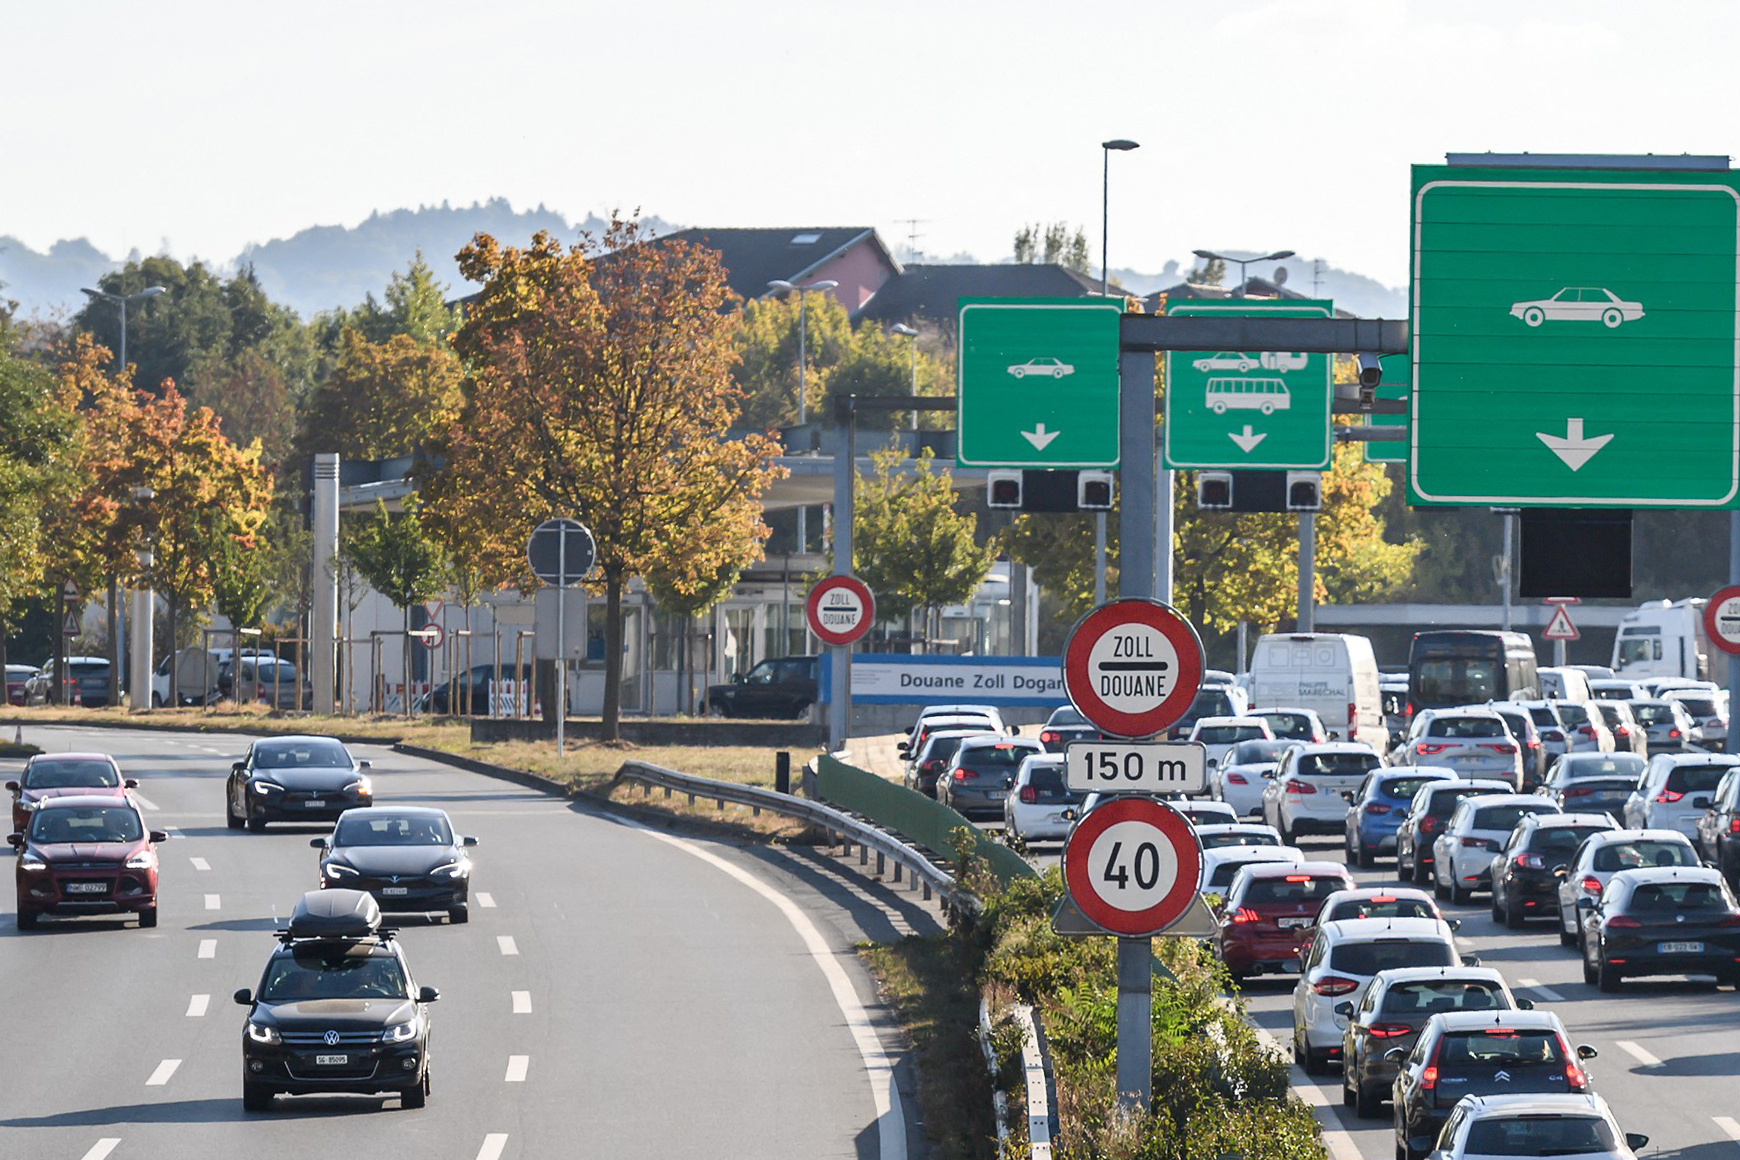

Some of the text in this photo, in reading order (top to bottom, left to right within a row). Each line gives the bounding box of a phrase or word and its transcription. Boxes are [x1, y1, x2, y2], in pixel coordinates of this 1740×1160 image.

[829, 593, 851, 605] ZOLL
[823, 613, 856, 626] DOUANE
[1113, 636, 1154, 658] ZOLL
[900, 673, 965, 688] Douane
[973, 673, 1005, 689] Zoll
[1100, 675, 1167, 697] DOUANE
[1084, 751, 1187, 782] 150 m
[1103, 841, 1161, 890] 40
